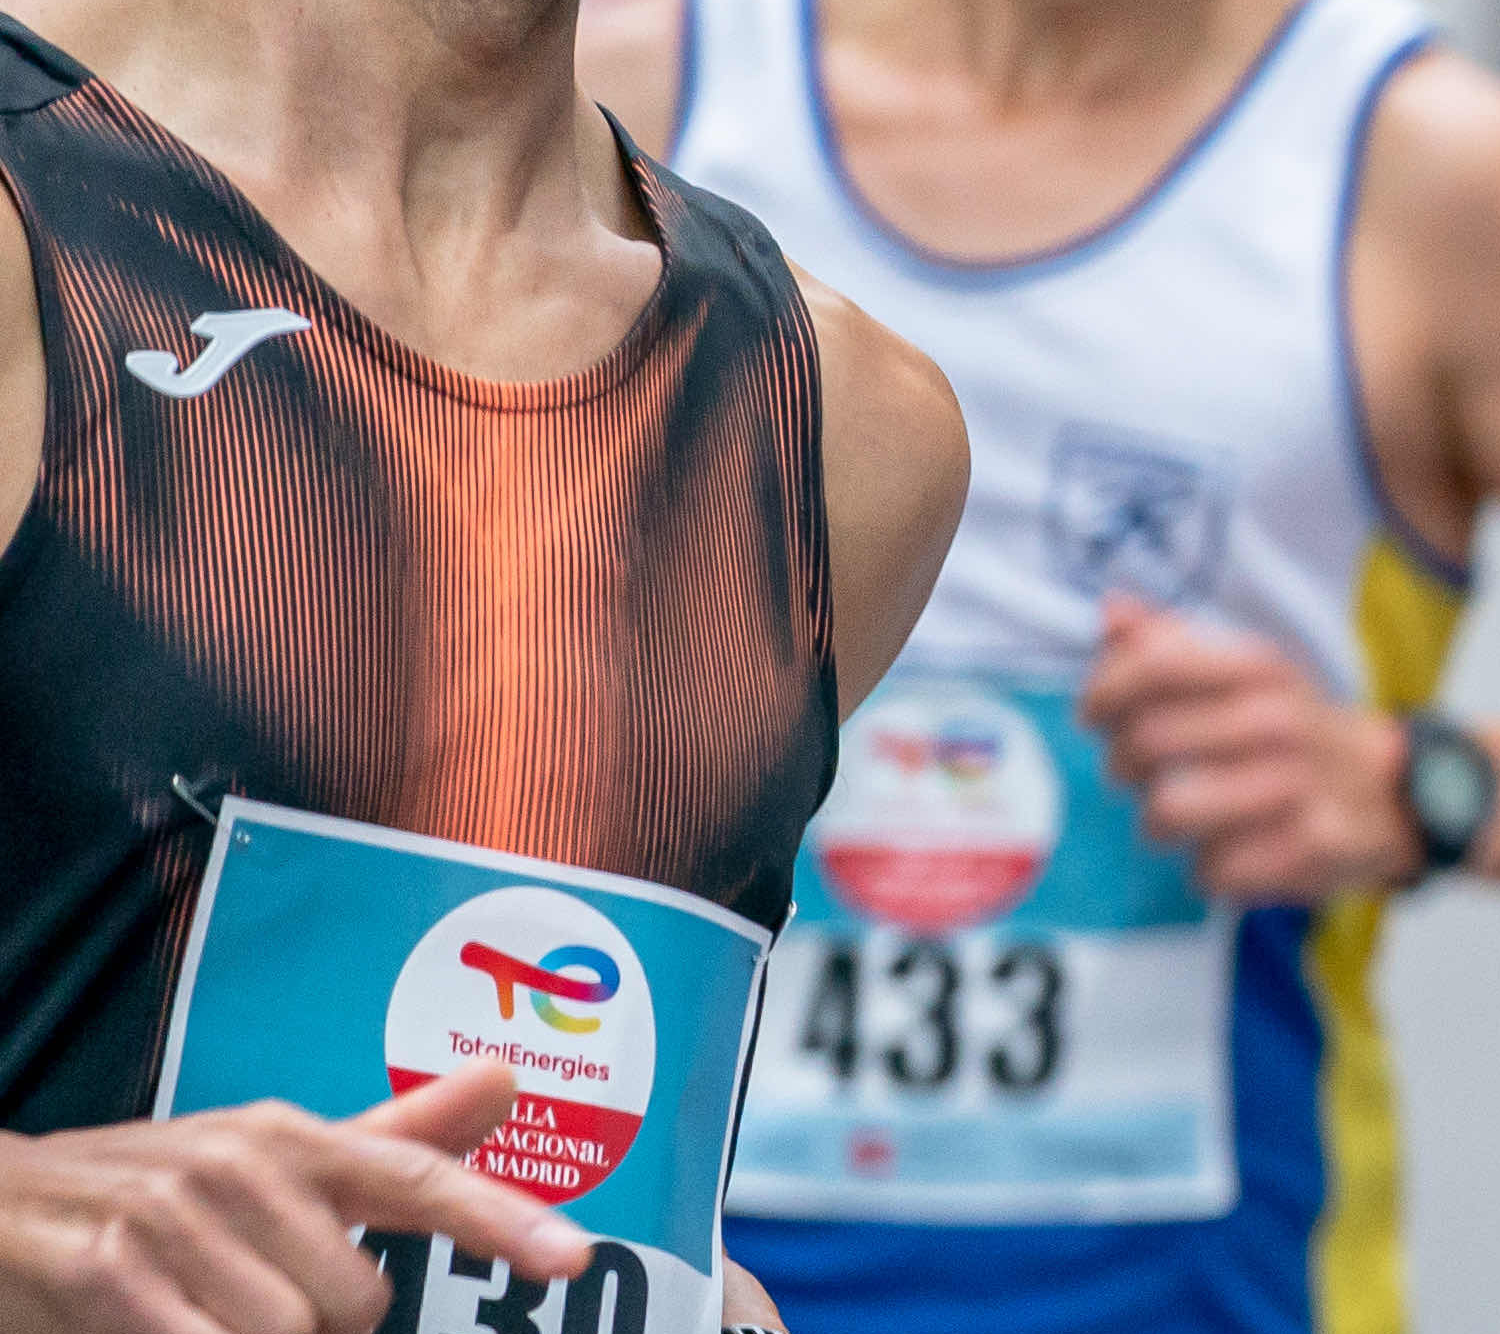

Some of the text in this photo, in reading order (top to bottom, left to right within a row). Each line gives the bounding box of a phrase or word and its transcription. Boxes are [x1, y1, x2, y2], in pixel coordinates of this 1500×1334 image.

[797, 939, 1068, 1095] 433
[510, 1100, 556, 1130] LLA
[485, 1156, 581, 1188] MADRID
